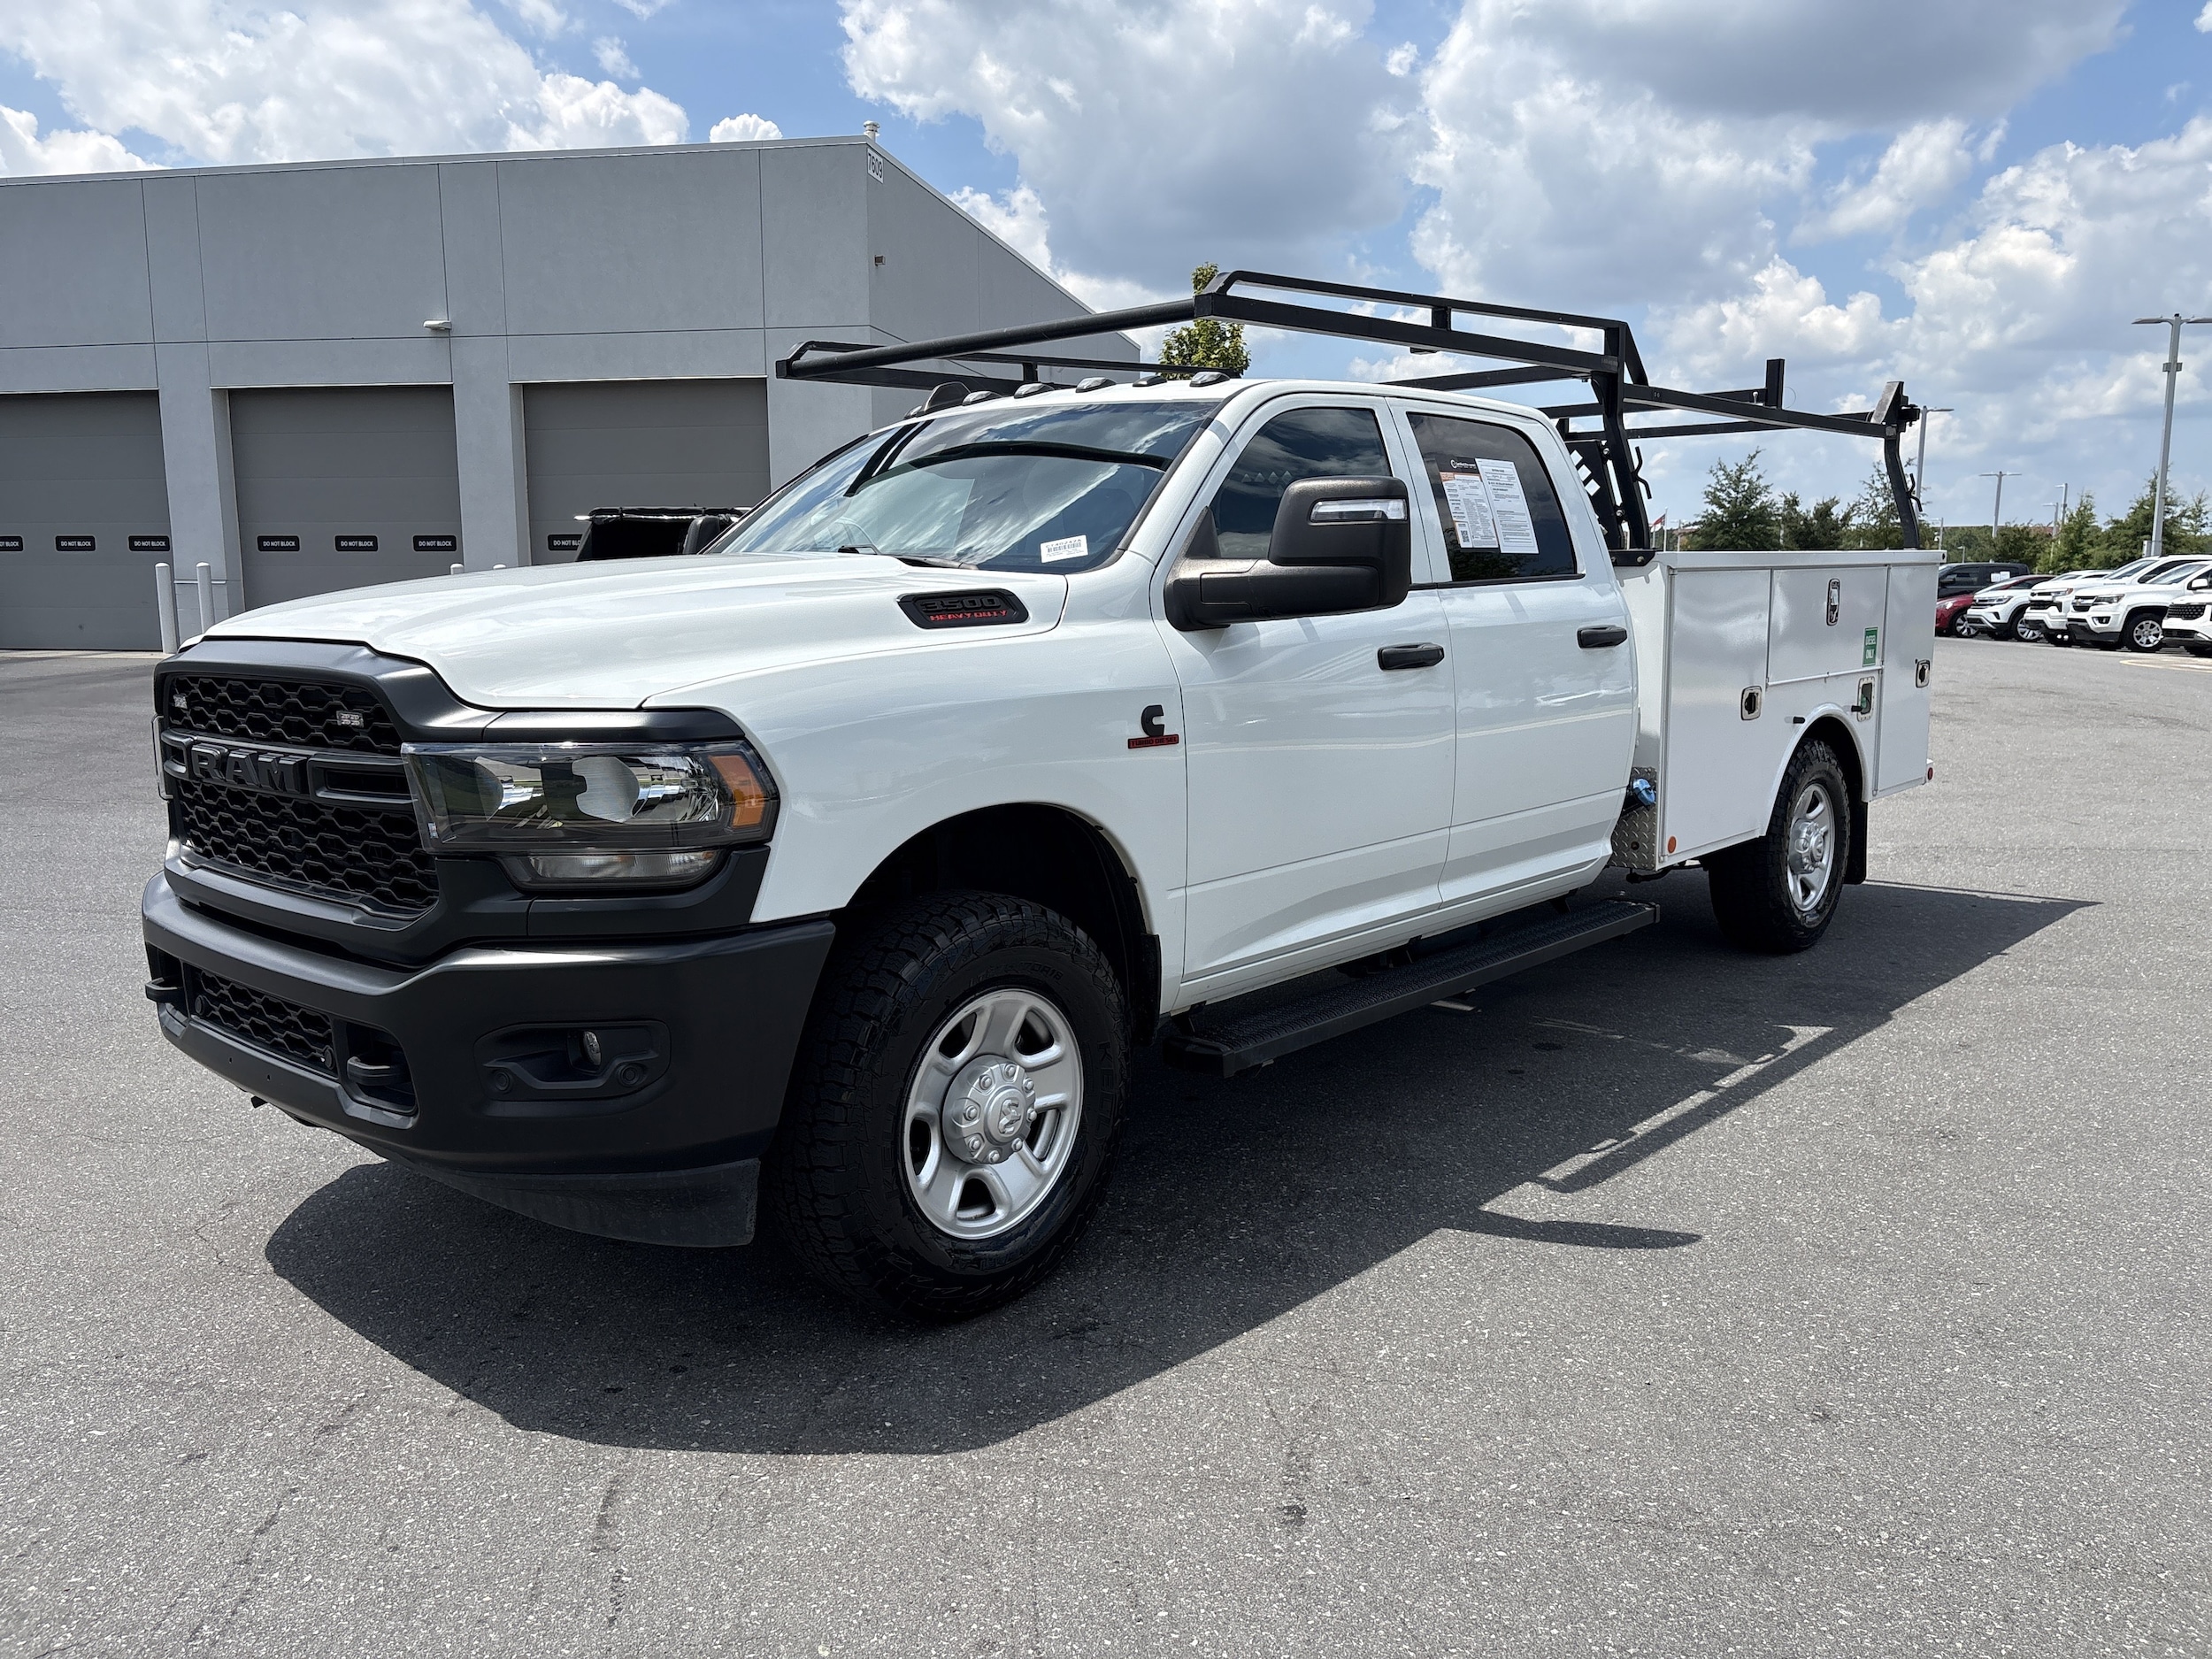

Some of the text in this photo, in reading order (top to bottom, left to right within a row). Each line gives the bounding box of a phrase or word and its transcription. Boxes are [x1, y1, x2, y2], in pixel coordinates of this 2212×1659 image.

[921, 596, 1001, 612] 3500
[929, 612, 972, 621] HEAVY
[1865, 634, 1876, 645] DIESEL
[1865, 649, 1875, 659] ONLY
[1131, 738, 1154, 747] TURBO
[190, 742, 308, 794] RAM
